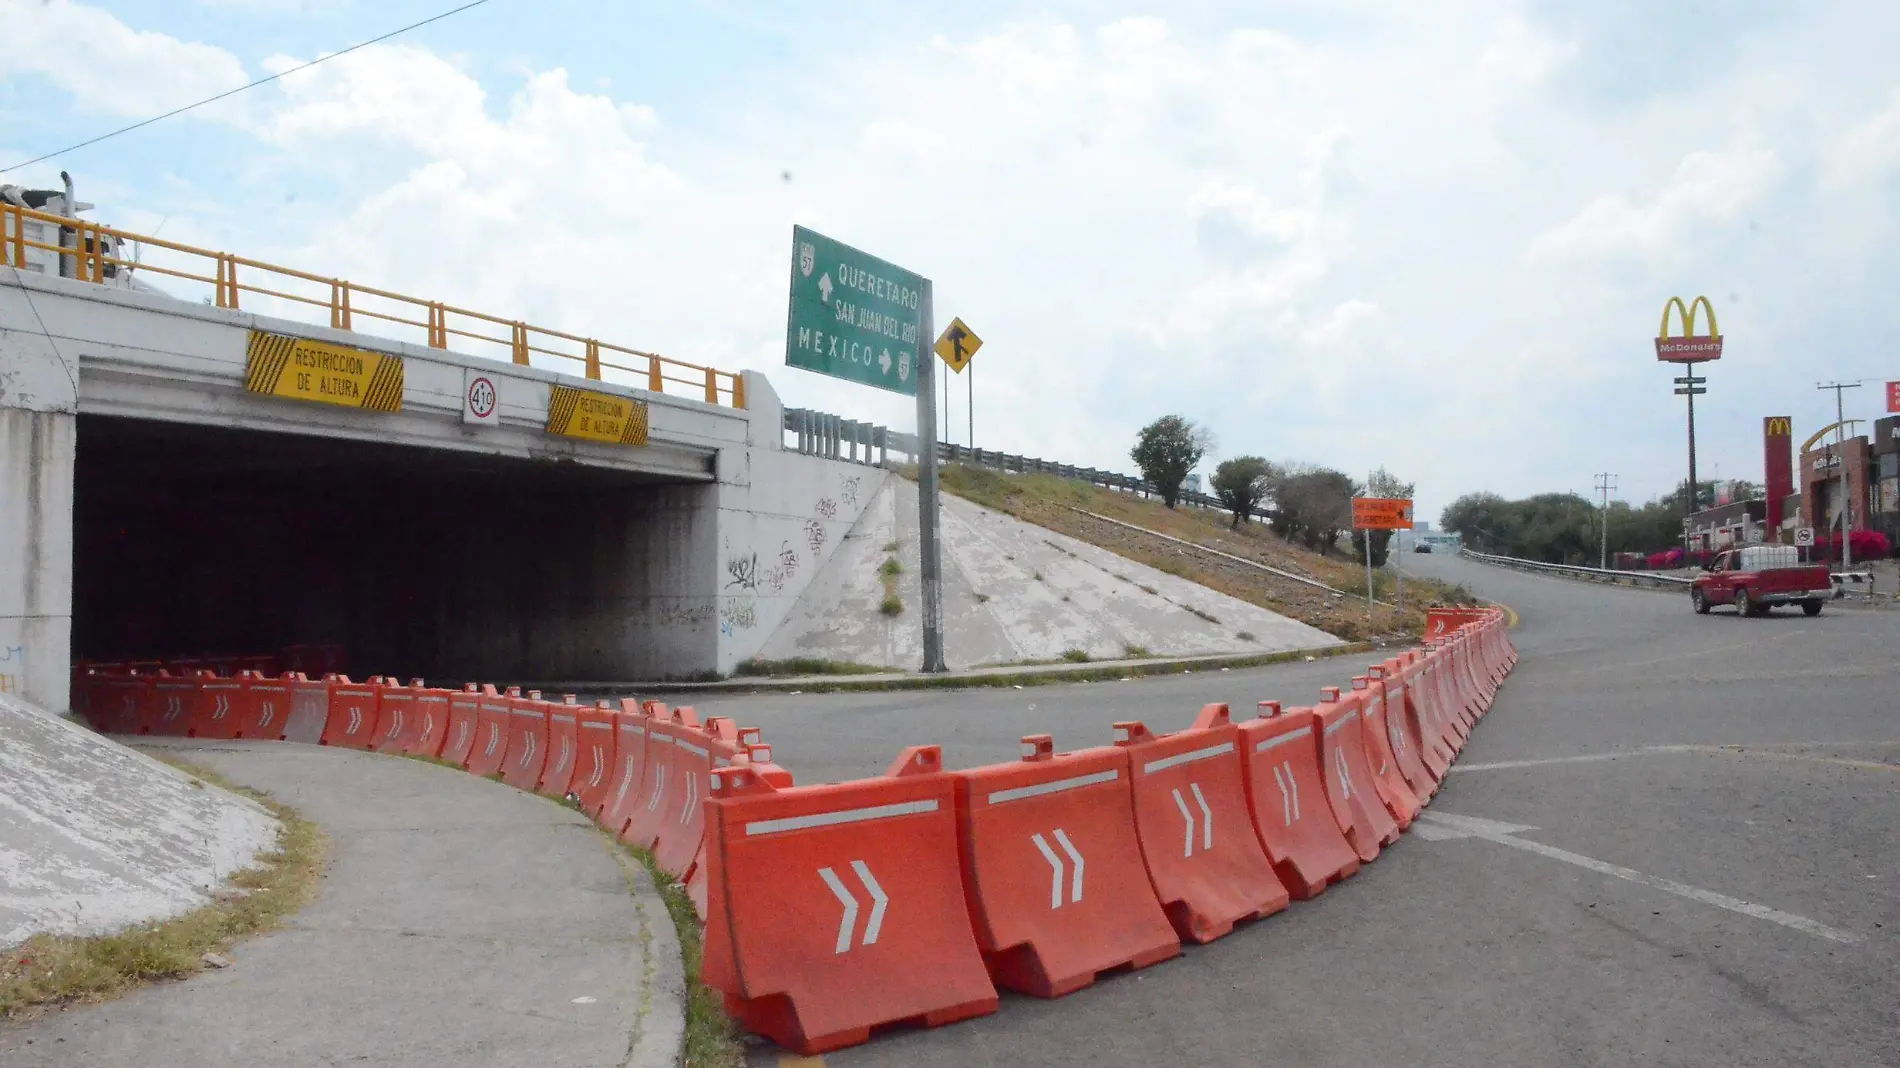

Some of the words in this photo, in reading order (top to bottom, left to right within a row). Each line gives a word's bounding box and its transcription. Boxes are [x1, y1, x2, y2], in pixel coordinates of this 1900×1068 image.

[802, 257, 812, 272] 57
[838, 263, 918, 310] QUERETARO
[835, 299, 855, 325] SAN
[857, 307, 881, 333] JUAN
[883, 314, 899, 340] DEL
[901, 322, 917, 345] RIO
[799, 326, 872, 367] MEXICO
[1660, 343, 1722, 352] McDonald's
[295, 347, 363, 375] RESTRICCION
[297, 372, 311, 391] DE
[319, 375, 360, 398] ALTURA
[579, 397, 623, 419] RESTRICCION
[579, 416, 589, 432] DE
[593, 420, 620, 436] ALTURA
